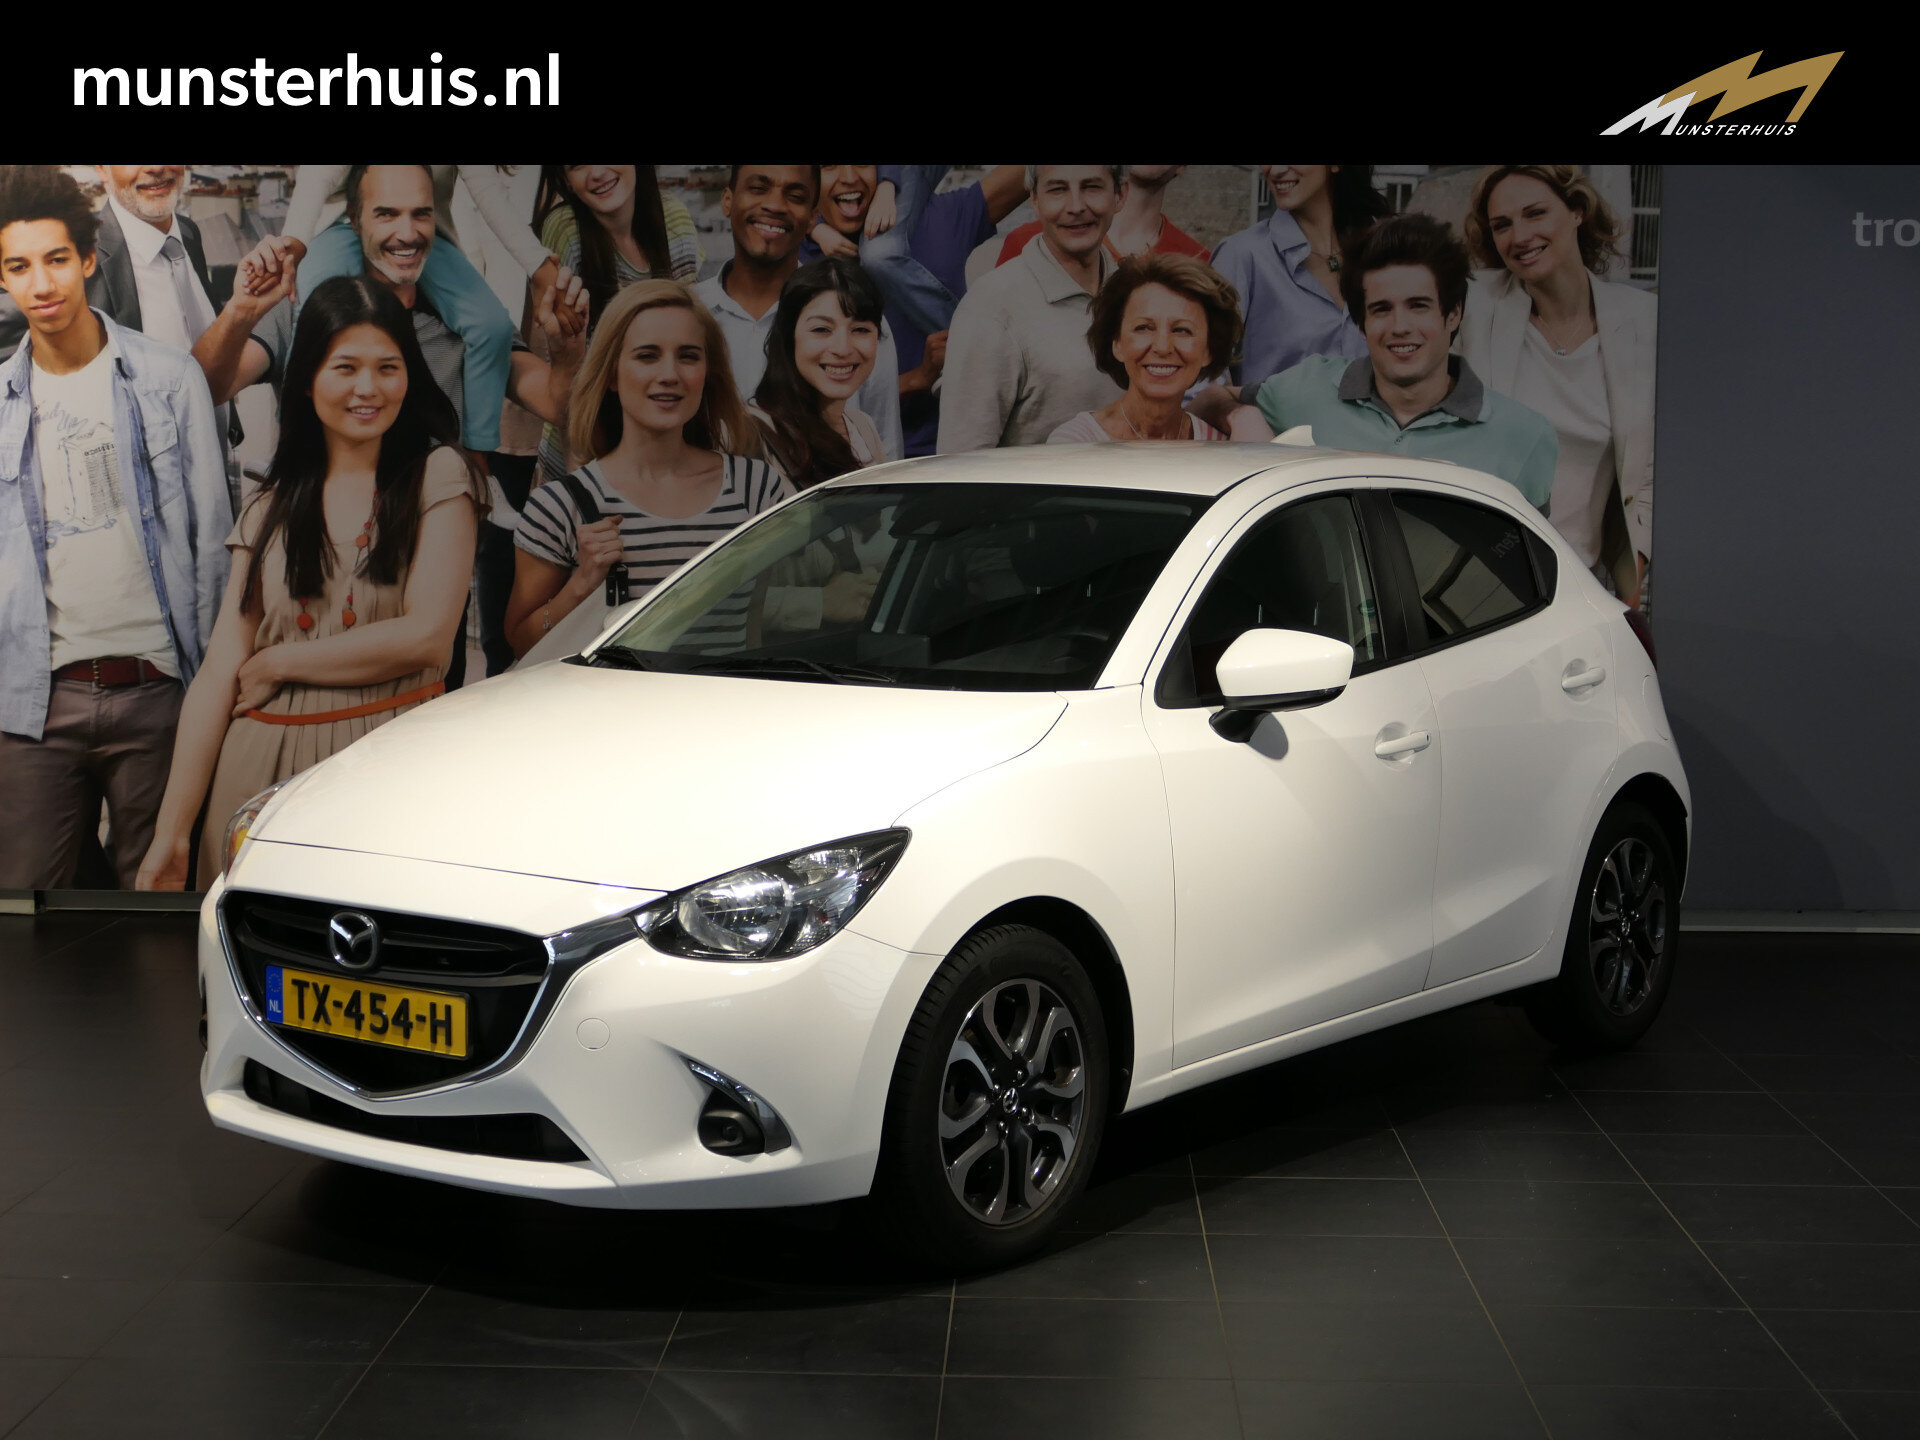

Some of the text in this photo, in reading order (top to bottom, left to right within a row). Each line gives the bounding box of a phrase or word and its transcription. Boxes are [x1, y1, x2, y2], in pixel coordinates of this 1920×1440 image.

[1852, 212, 1920, 247] tro
[269, 1000, 282, 1013] NL
[291, 979, 452, 1047] TX-454-H
